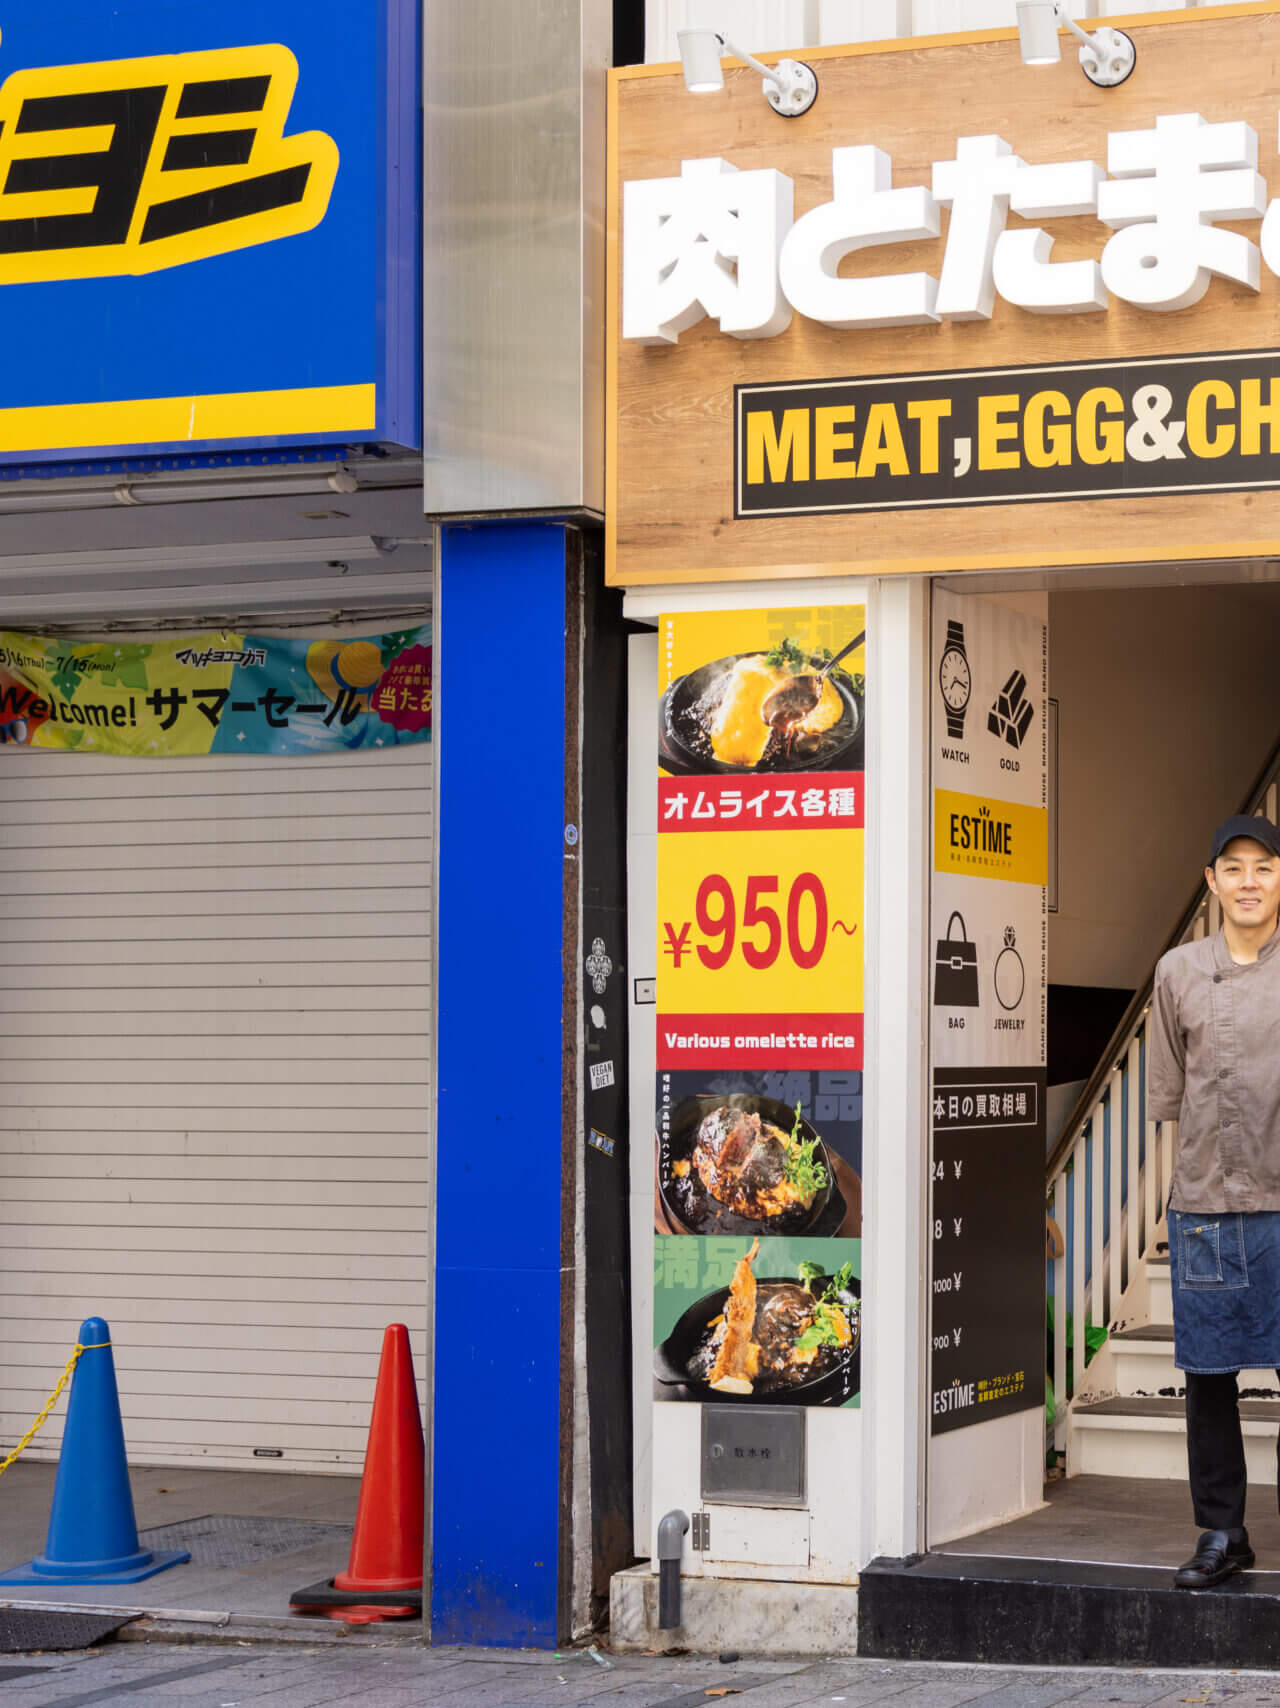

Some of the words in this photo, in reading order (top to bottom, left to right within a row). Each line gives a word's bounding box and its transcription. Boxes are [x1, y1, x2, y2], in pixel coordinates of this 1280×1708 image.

[146, 687, 362, 732] サマーセール
[941, 747, 970, 765] WATCH
[999, 758, 1020, 773] GOLD
[663, 787, 856, 821] オムライス各種
[950, 813, 1012, 856] ESTIME
[948, 1017, 965, 1030] BAG
[993, 1018, 1025, 1031] JEWELRY
[665, 1032, 730, 1049] Various
[735, 1031, 817, 1049] omelette
[822, 1032, 855, 1049] rice
[591, 1064, 613, 1077] VEGAN
[595, 1075, 610, 1087] DIET
[933, 1093, 1026, 1119] 本日の買取相場
[953, 1160, 963, 1180] ¥
[953, 1218, 962, 1237] ¥
[953, 1272, 962, 1291] ¥
[953, 1328, 962, 1347] ¥
[933, 1383, 975, 1415] ESTIME
